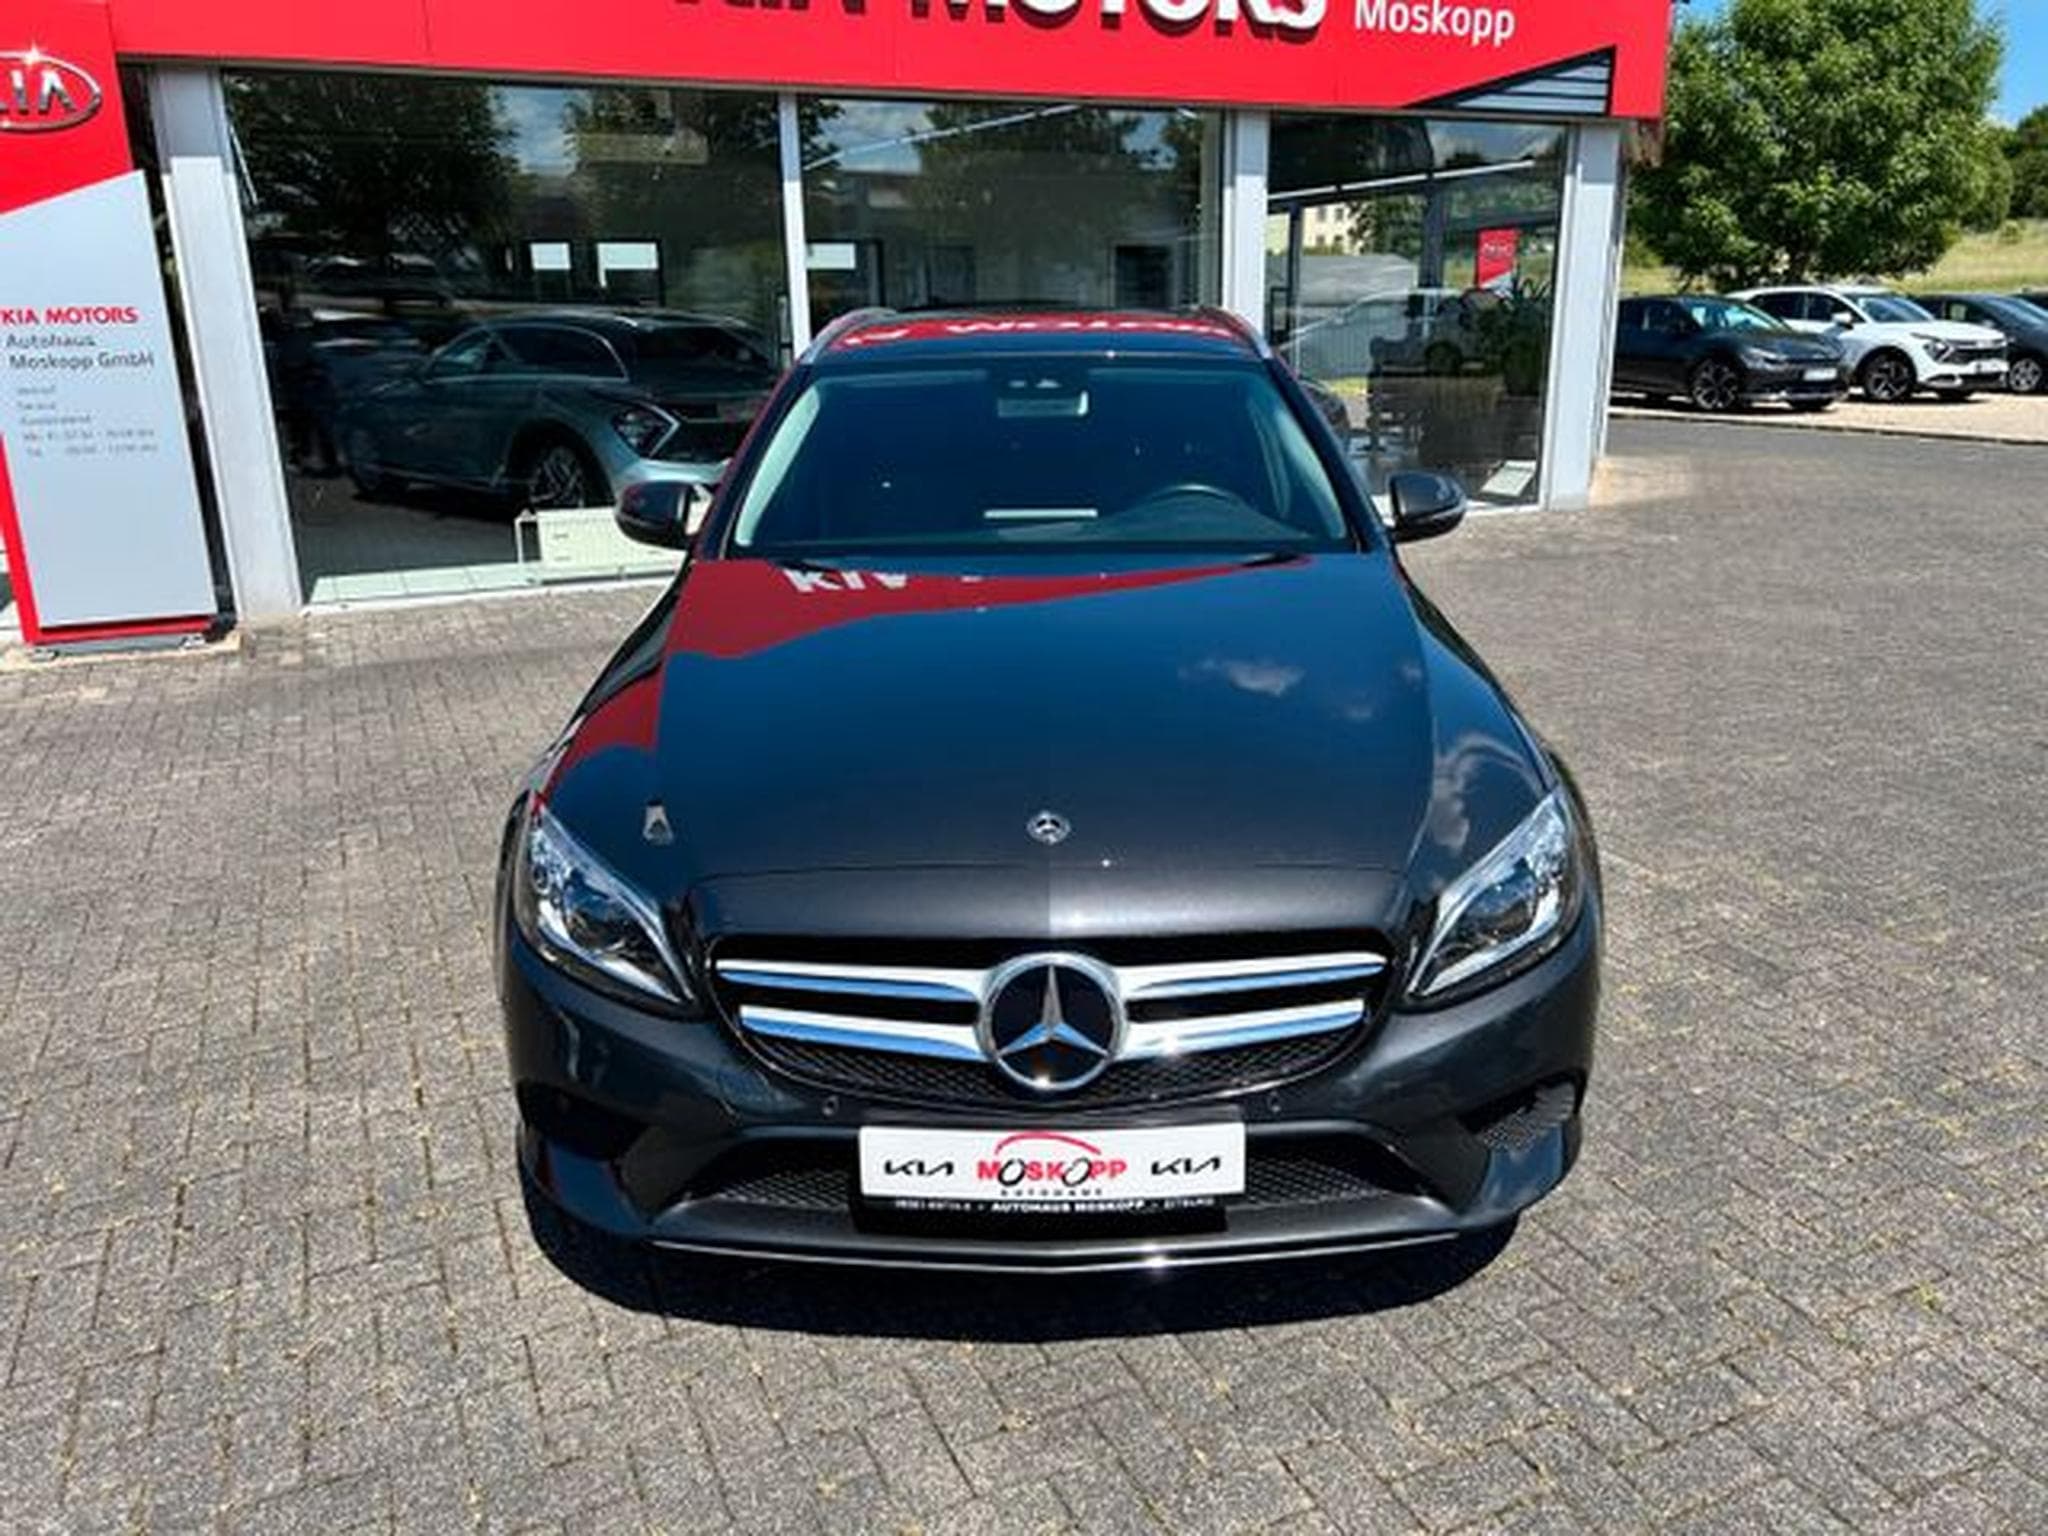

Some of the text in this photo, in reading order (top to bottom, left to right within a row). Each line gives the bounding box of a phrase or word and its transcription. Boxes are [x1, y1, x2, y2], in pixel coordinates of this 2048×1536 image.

[1354, 0, 1516, 47] Moskopp
[0, 69, 76, 113] IA
[1, 306, 139, 325] KIA MOTORS
[6, 333, 97, 349] Autohaus
[9, 351, 155, 371] Moskopp GmbH
[884, 1158, 955, 1177] KIA
[976, 1156, 1128, 1188] MOSKOPP
[1150, 1155, 1222, 1177] KIA
[991, 1201, 1070, 1214] AUTOHAUS
